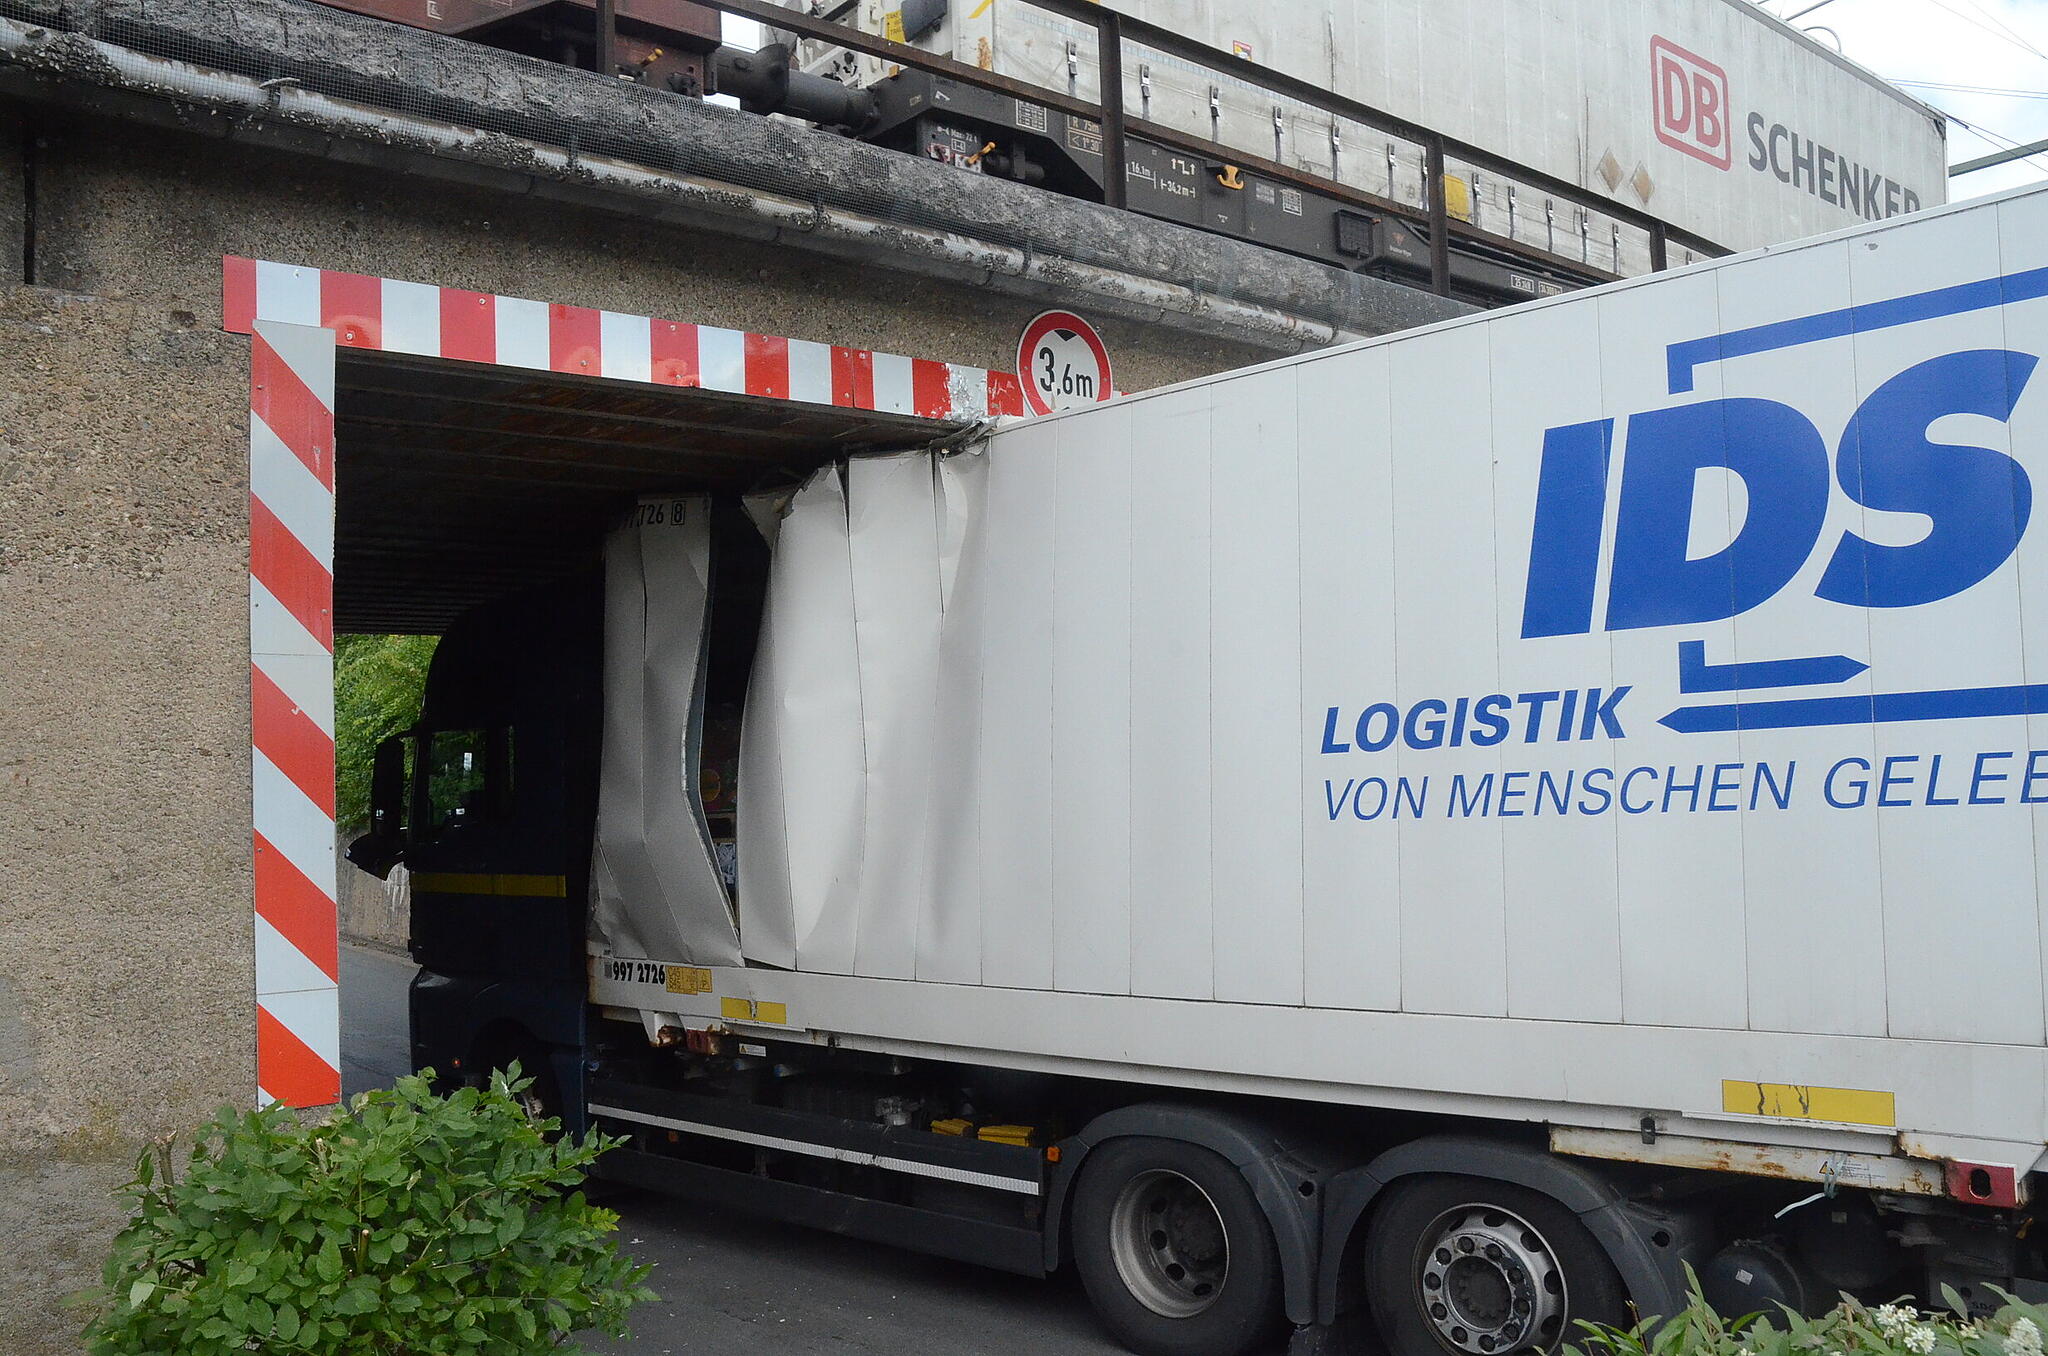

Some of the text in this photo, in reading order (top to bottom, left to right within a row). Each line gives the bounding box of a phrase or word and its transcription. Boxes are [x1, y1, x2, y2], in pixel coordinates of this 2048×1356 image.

[1661, 55, 1722, 148] DB
[1039, 346, 1093, 398] 3,6m
[1519, 349, 2040, 640] IDS
[1321, 686, 1633, 755] LOGISTIK
[1323, 777, 1429, 821] VON
[1447, 760, 1797, 819] MENSCHEN
[612, 960, 634, 981] 997
[636, 963, 666, 985] 2726
